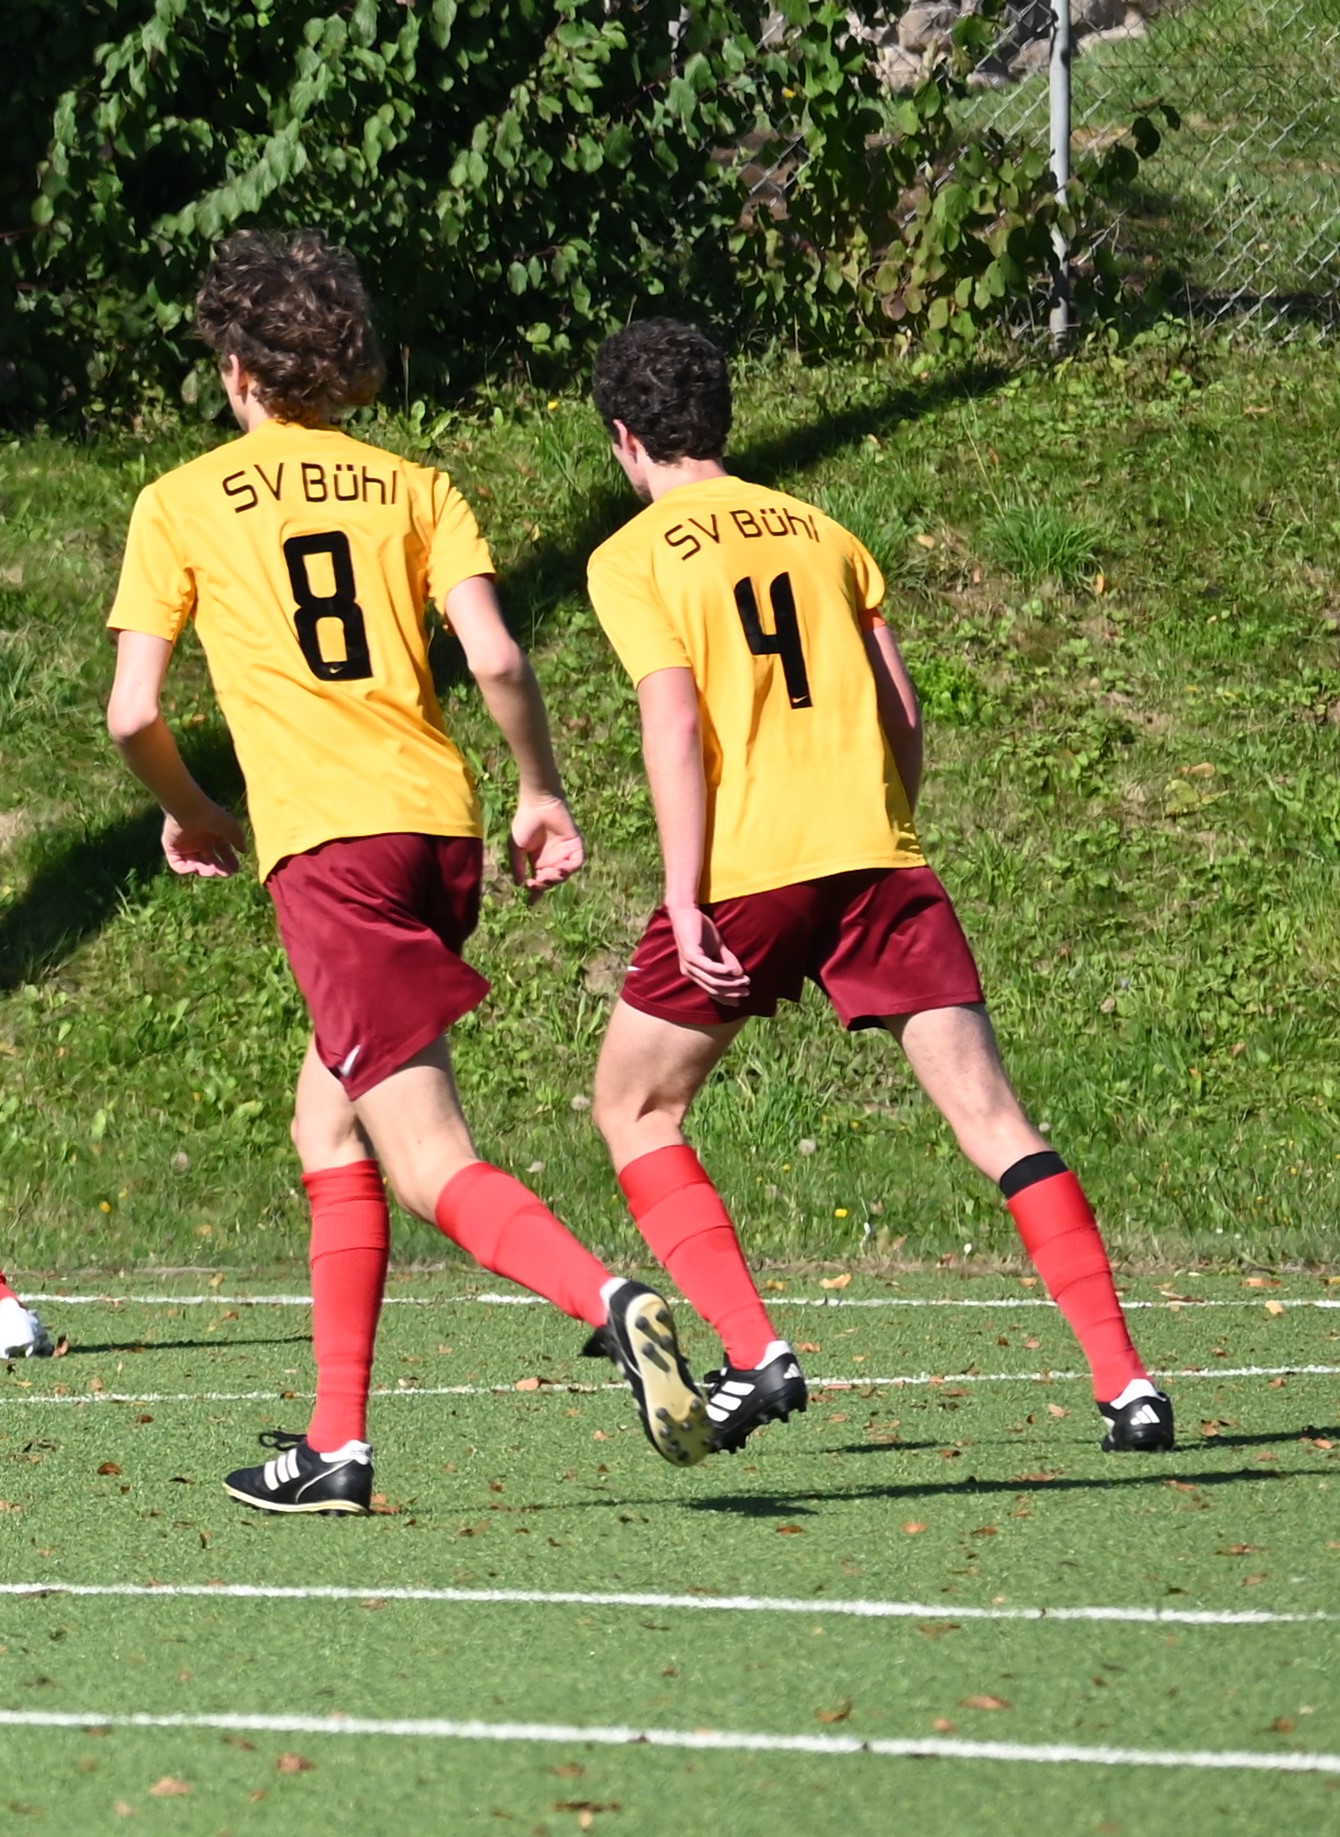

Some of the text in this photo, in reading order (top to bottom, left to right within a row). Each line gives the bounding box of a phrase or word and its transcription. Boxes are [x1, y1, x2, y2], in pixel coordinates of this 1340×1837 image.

[221, 462, 399, 514] SV Bühl
[663, 506, 821, 562] SV Bühl
[282, 530, 375, 682] 8
[733, 571, 814, 711] 4
